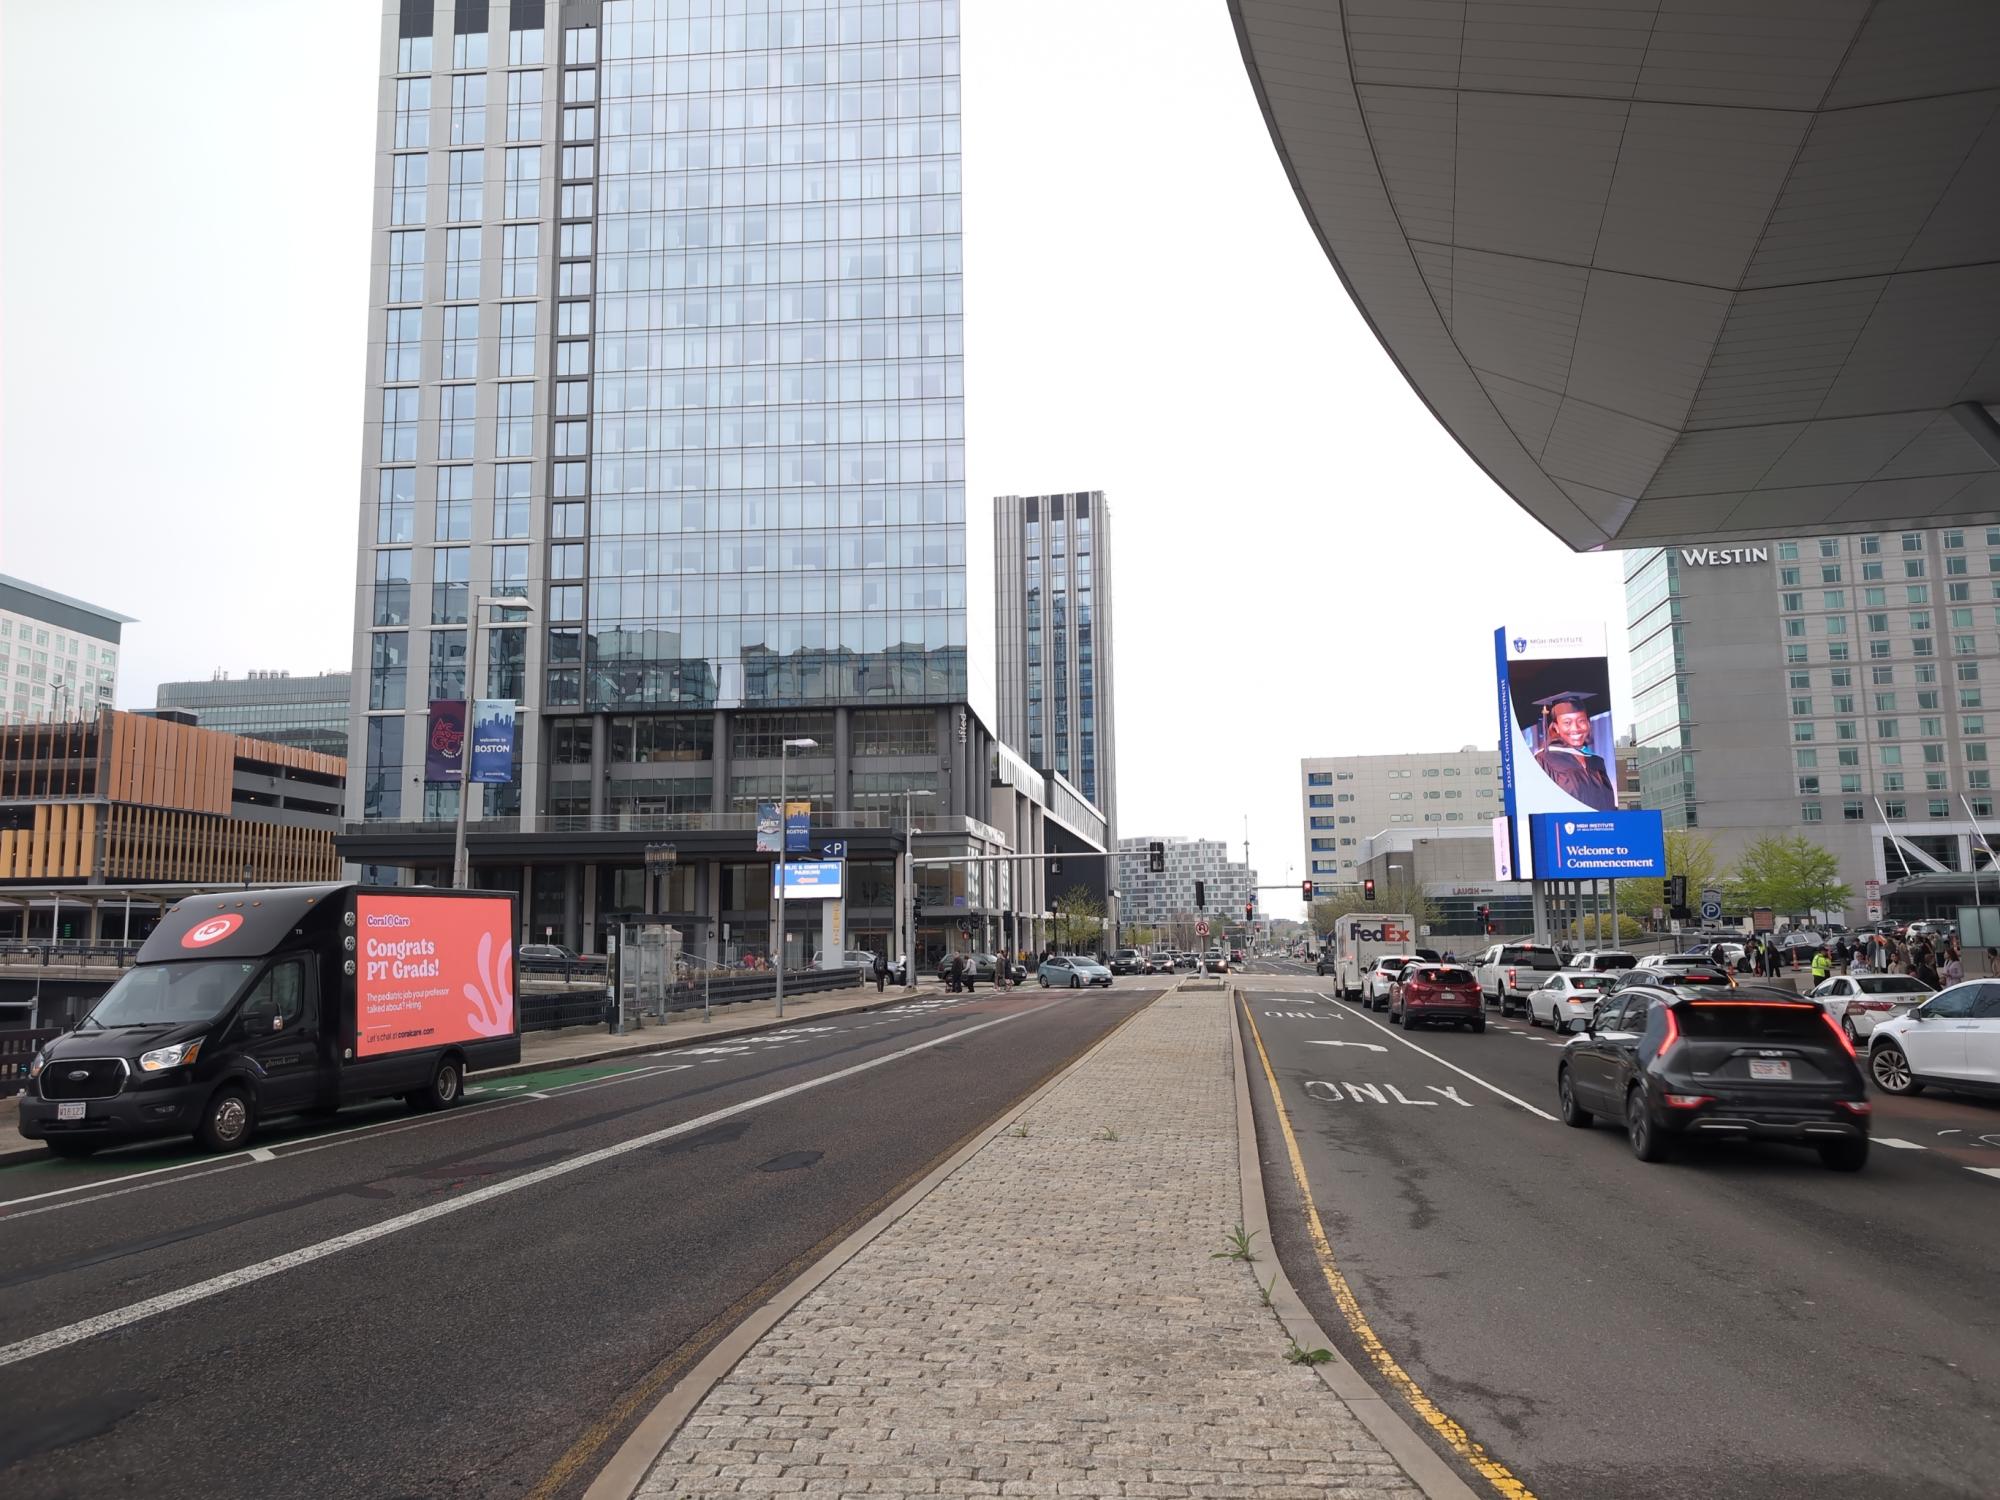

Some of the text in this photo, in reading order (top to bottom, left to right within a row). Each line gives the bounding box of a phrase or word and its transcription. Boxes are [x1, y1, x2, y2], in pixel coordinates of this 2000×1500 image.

[1681, 547, 1768, 566] WESTIN
[1500, 679, 1511, 762] Commencement
[474, 744, 510, 753] BOSTON
[834, 843, 842, 855] P
[1566, 846, 1628, 855] Welcome to
[1567, 859, 1654, 868] Commencement
[1706, 906, 1717, 916] P
[367, 915, 410, 926] Coral Care
[1350, 922, 1410, 942] FedEx
[367, 938, 435, 960] Congrats
[367, 958, 440, 981] PT Grads!
[367, 993, 378, 1001] The
[402, 989, 412, 1000] job
[412, 991, 424, 1000] your
[424, 988, 450, 998] professor
[367, 1005, 386, 1013] talked
[1264, 1010, 1345, 1021] ONLY
[1304, 1080, 1475, 1107] ONLY
